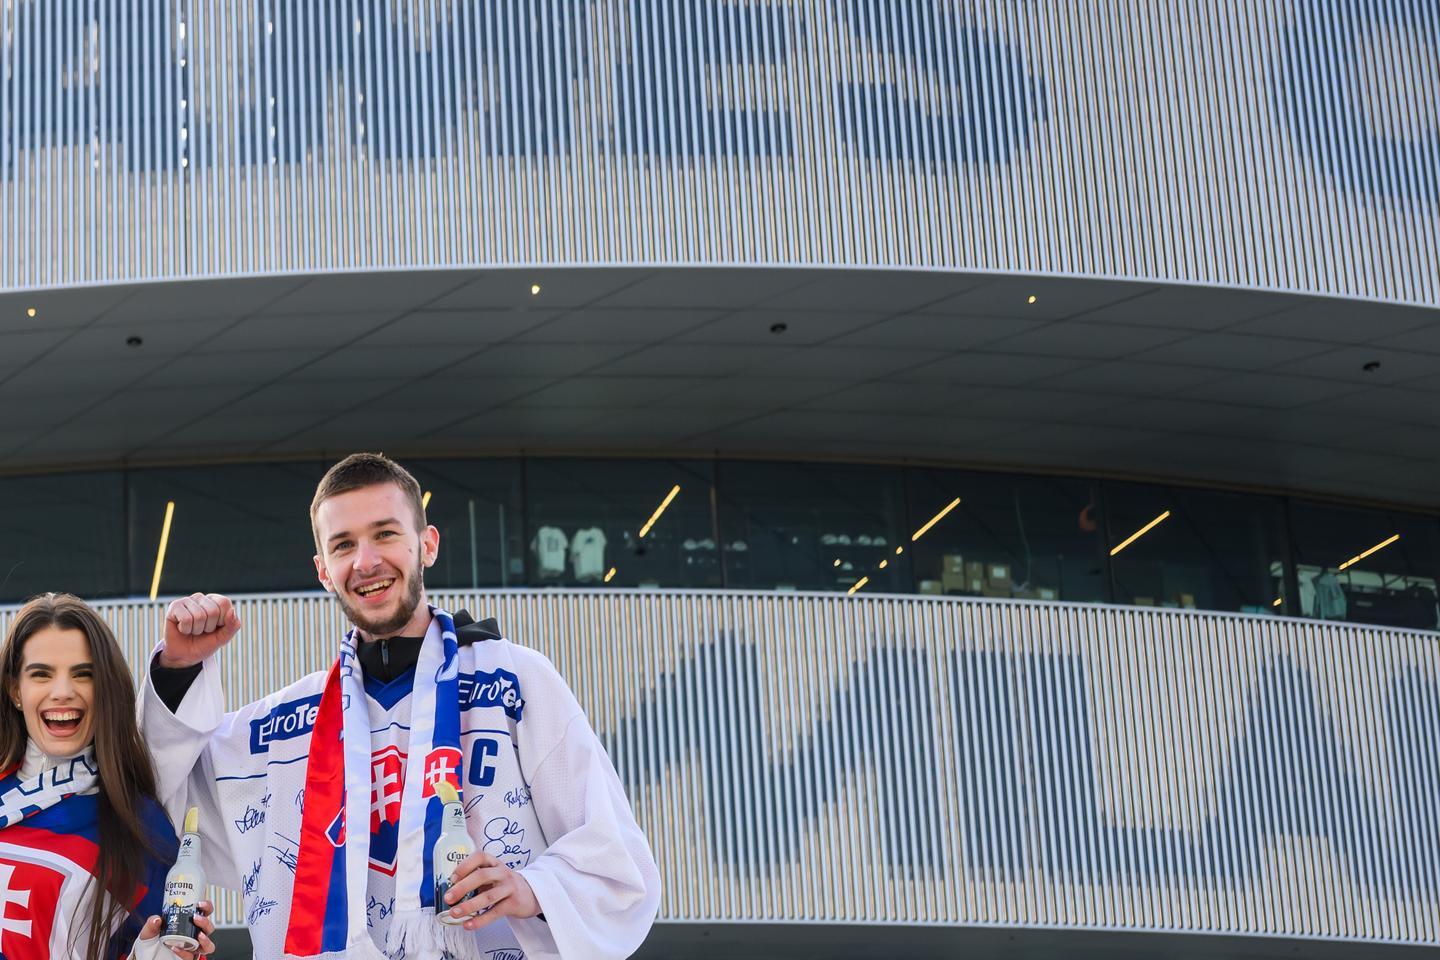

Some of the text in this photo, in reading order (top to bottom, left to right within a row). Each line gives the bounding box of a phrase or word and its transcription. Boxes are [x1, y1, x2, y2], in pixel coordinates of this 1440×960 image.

[469, 738, 499, 787] C
[601, 628, 1440, 900] MILA
[165, 881, 193, 892] Corona
